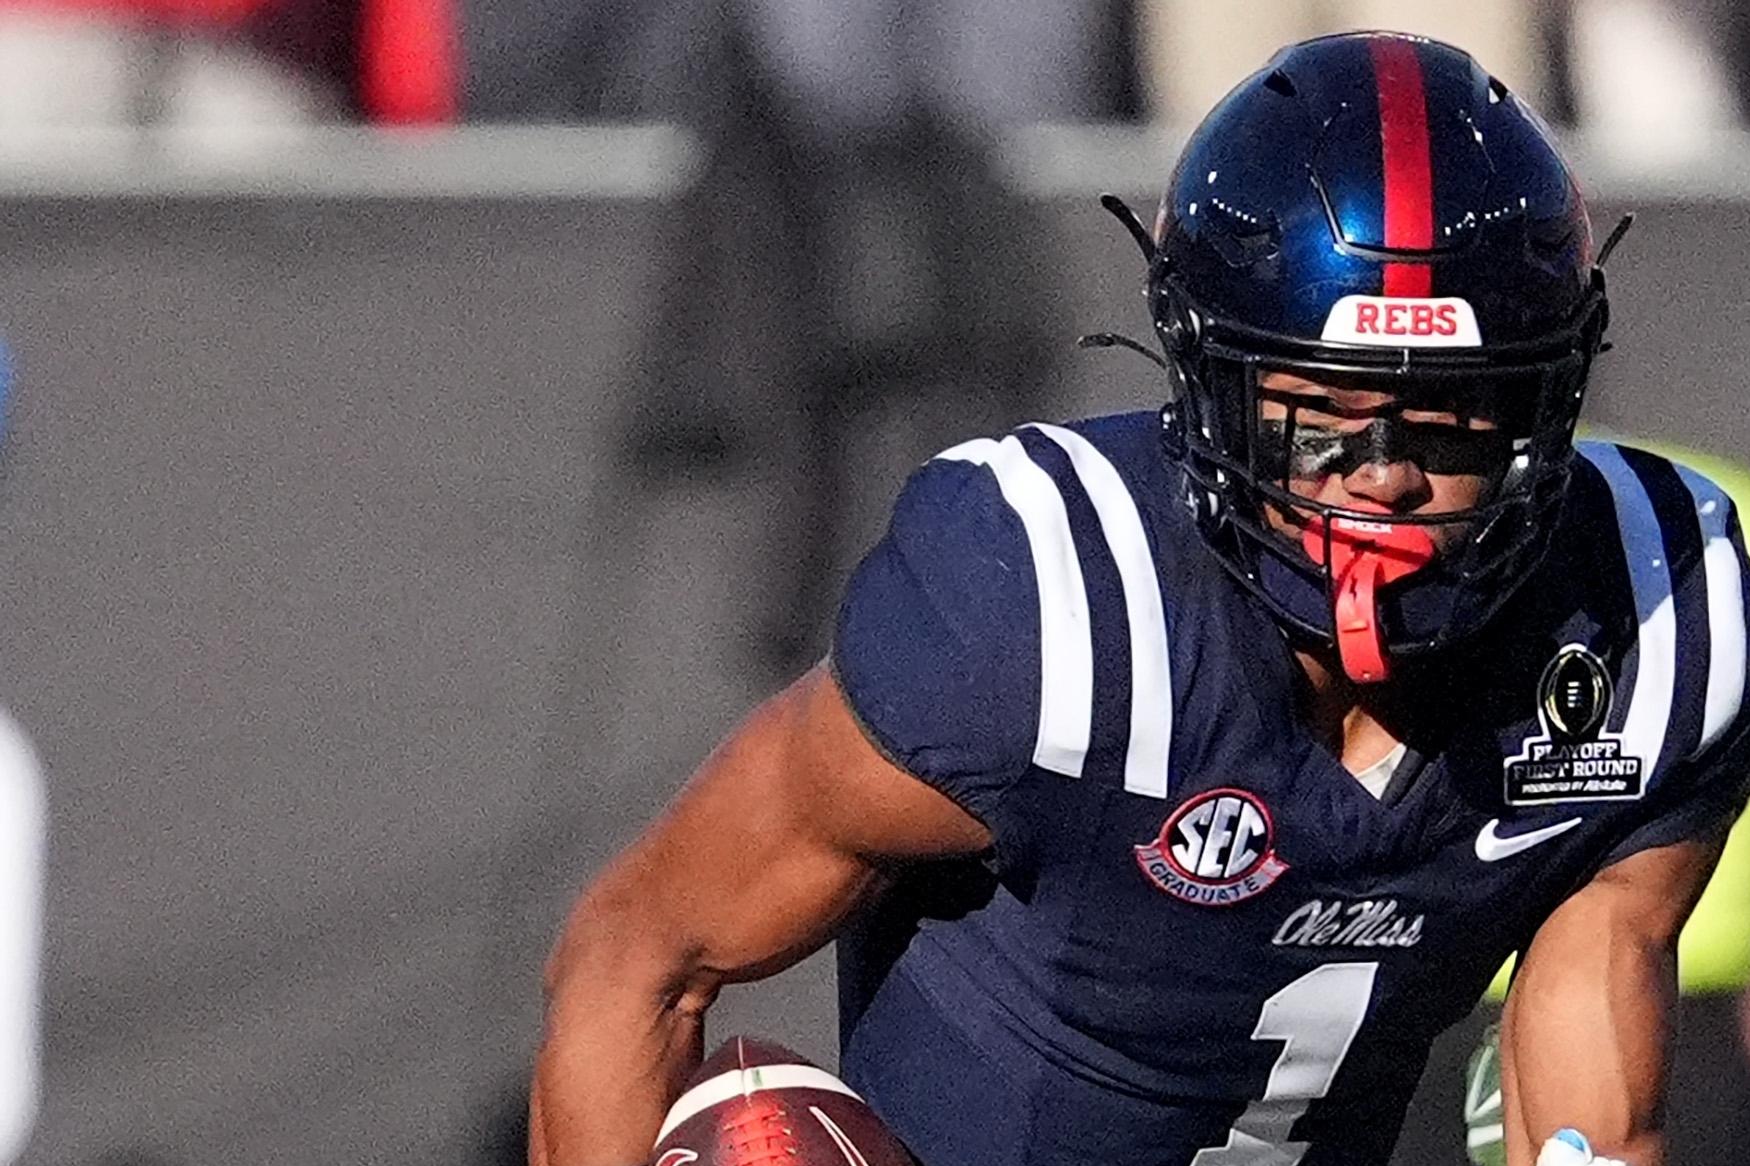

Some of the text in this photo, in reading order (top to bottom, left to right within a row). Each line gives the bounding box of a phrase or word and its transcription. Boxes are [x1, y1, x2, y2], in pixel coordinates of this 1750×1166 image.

[1355, 303, 1457, 335] REBS
[1513, 760, 1638, 780] FIRST ROUND
[1532, 742, 1619, 762] PLAYOFF
[1171, 797, 1266, 879] SEC
[1150, 862, 1261, 902] GRADUATE
[1271, 899, 1425, 948] Ole Miss
